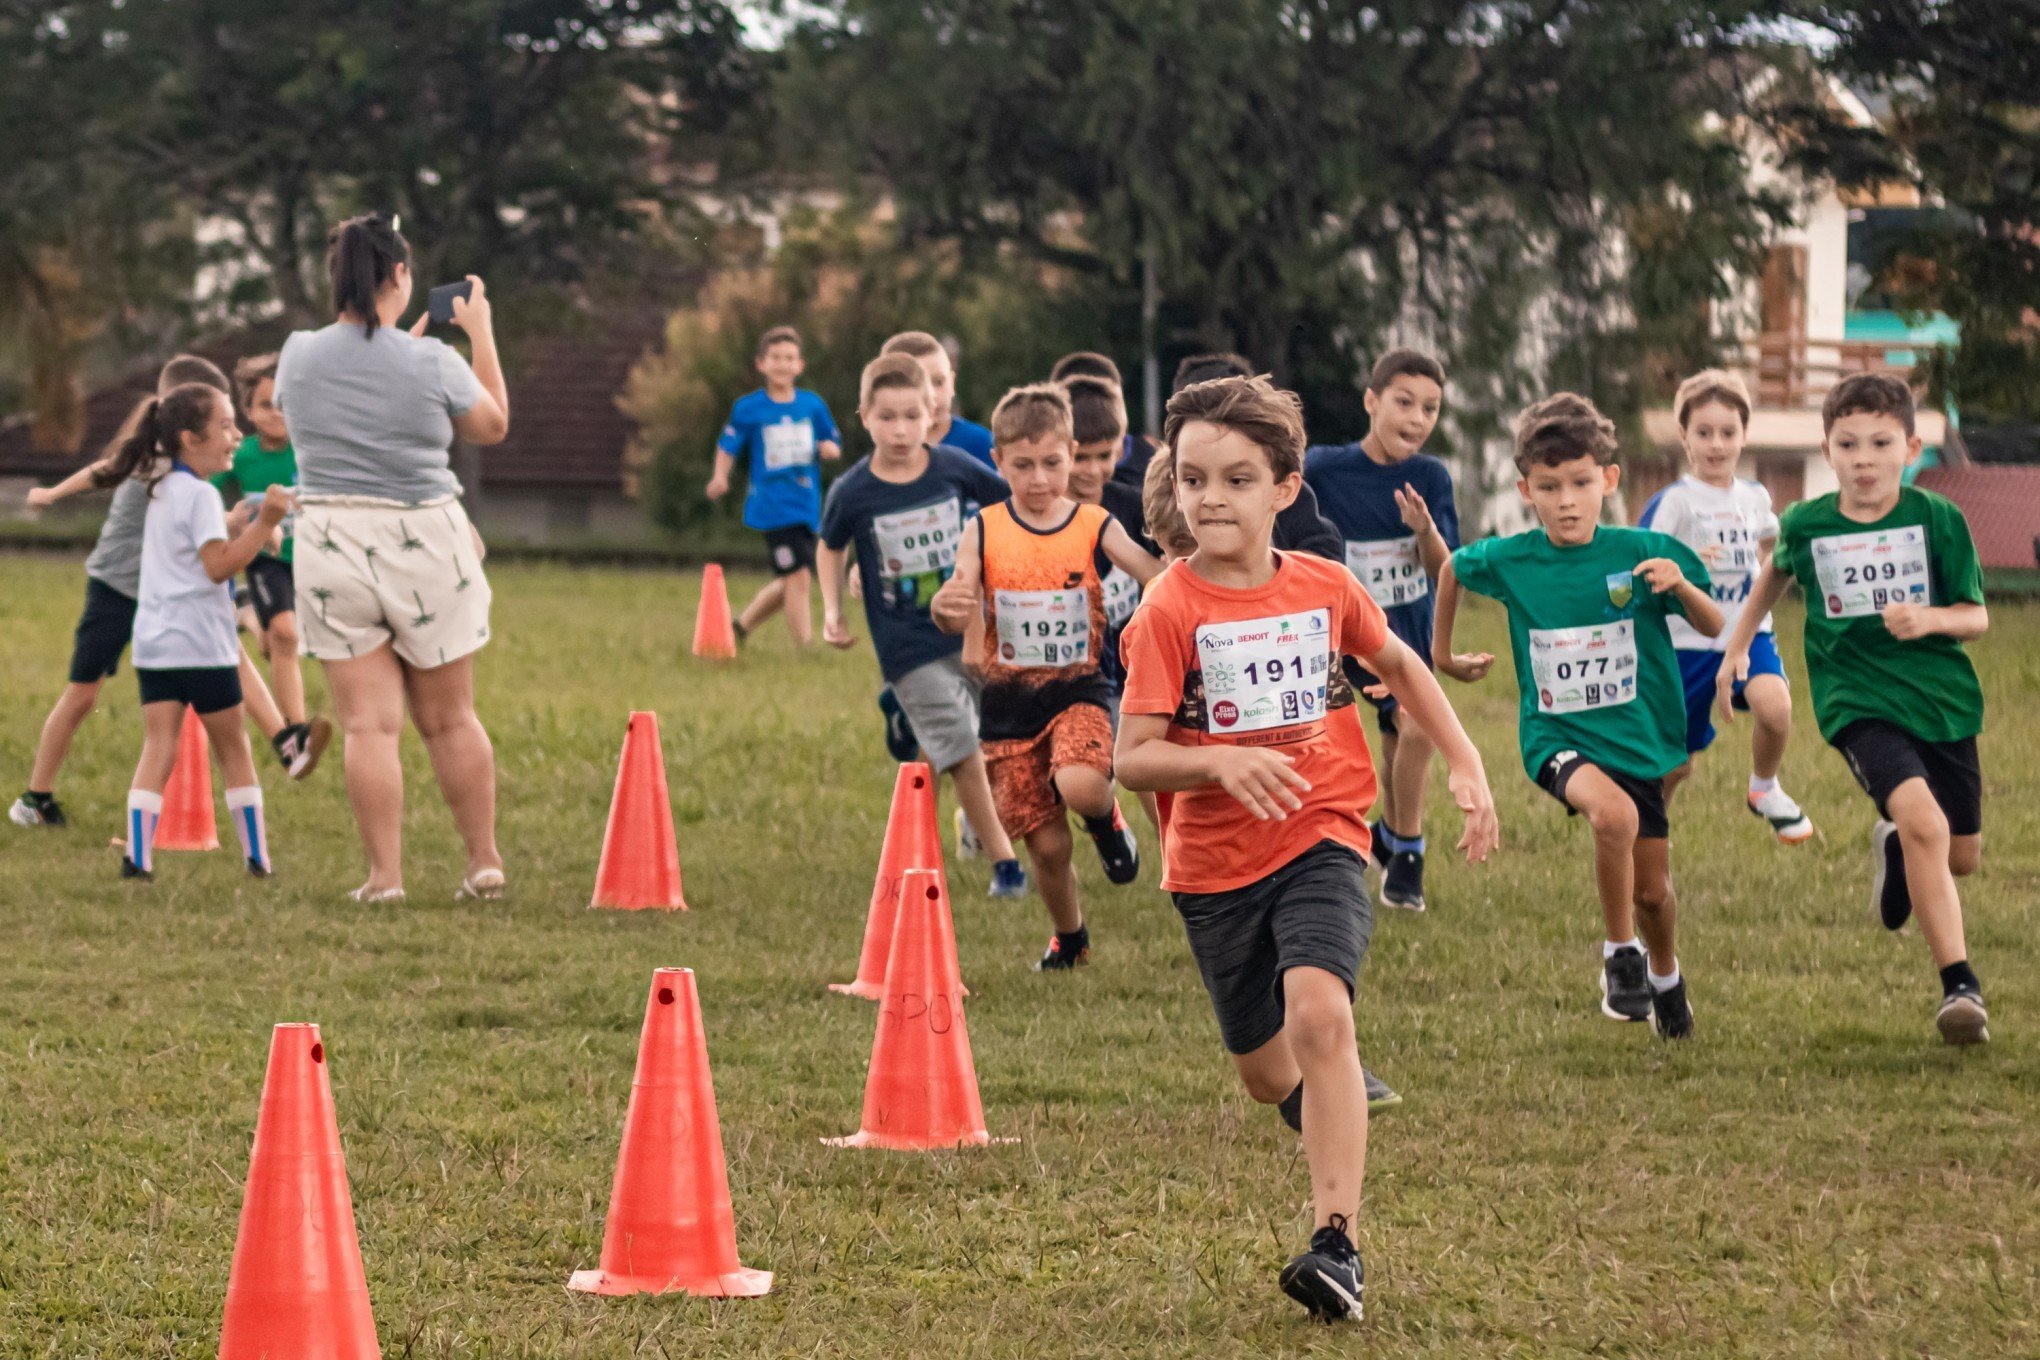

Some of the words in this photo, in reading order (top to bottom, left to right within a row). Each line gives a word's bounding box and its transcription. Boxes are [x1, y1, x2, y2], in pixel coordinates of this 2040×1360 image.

[904, 530, 943, 549] 080
[1372, 563, 1412, 584] 210
[1844, 562, 1896, 585] 209
[1021, 620, 1068, 637] 192
[1238, 632, 1270, 643] BENOIT
[1205, 638, 1234, 649] Nova
[1243, 655, 1303, 685] 191
[1557, 657, 1609, 680] 077
